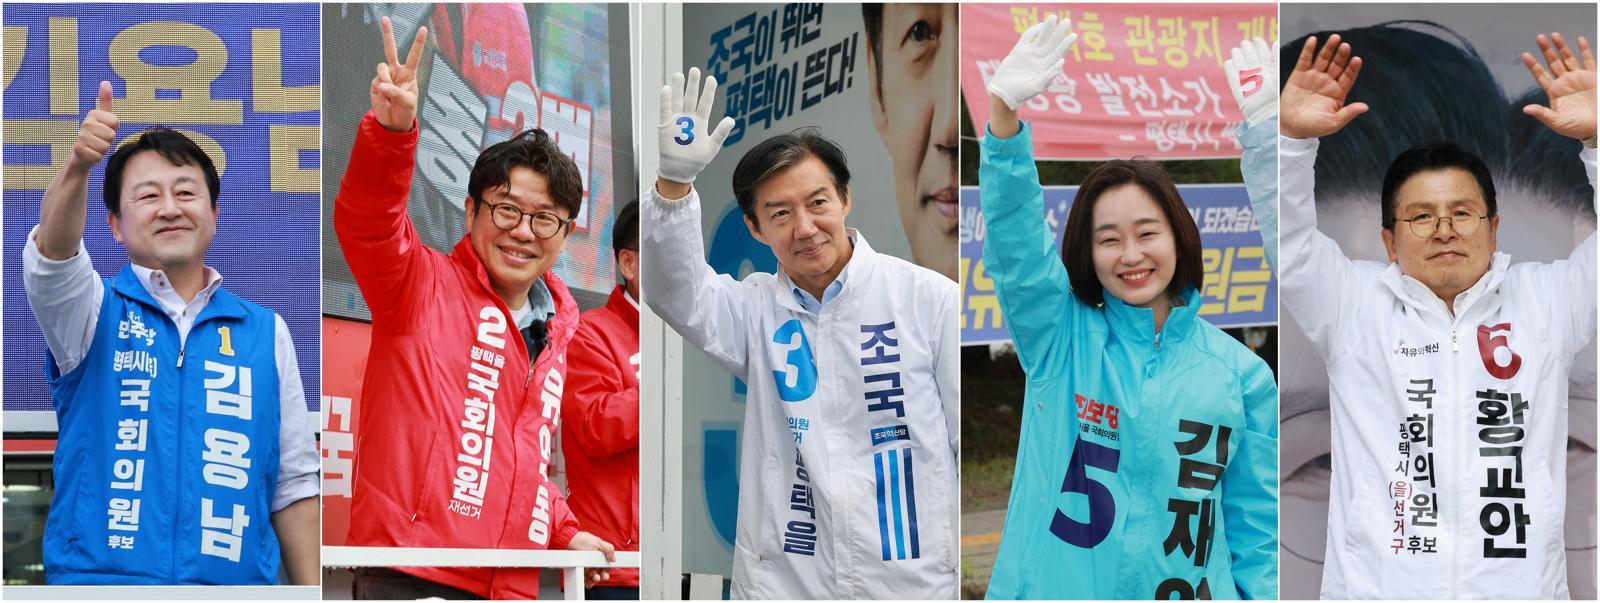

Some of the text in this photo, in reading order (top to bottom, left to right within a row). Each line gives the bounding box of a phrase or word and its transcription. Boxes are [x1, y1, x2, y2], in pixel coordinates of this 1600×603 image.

[707, 10, 778, 87] 조국이
[1124, 15, 1225, 69] 관광지
[722, 32, 859, 148] 평택이 뜬다!
[1085, 72, 1225, 119] 발전소가
[1239, 67, 1264, 98] 5
[674, 116, 695, 146] 3
[118, 320, 157, 347] 민주당
[218, 326, 235, 357] 1
[470, 345, 506, 369] 평택을
[477, 306, 507, 350] 2
[1476, 322, 1522, 380] 6
[772, 318, 819, 403] 3
[860, 321, 906, 418] 조국
[453, 361, 500, 507] 국회의원
[786, 416, 809, 431] 의원
[107, 379, 151, 550] 국회의원 후보
[201, 360, 252, 563] 김용남
[1406, 379, 1438, 555] 국회의원 후보
[1475, 388, 1532, 559] 황교안
[448, 499, 482, 520] 재선거
[1048, 433, 1121, 550] 5
